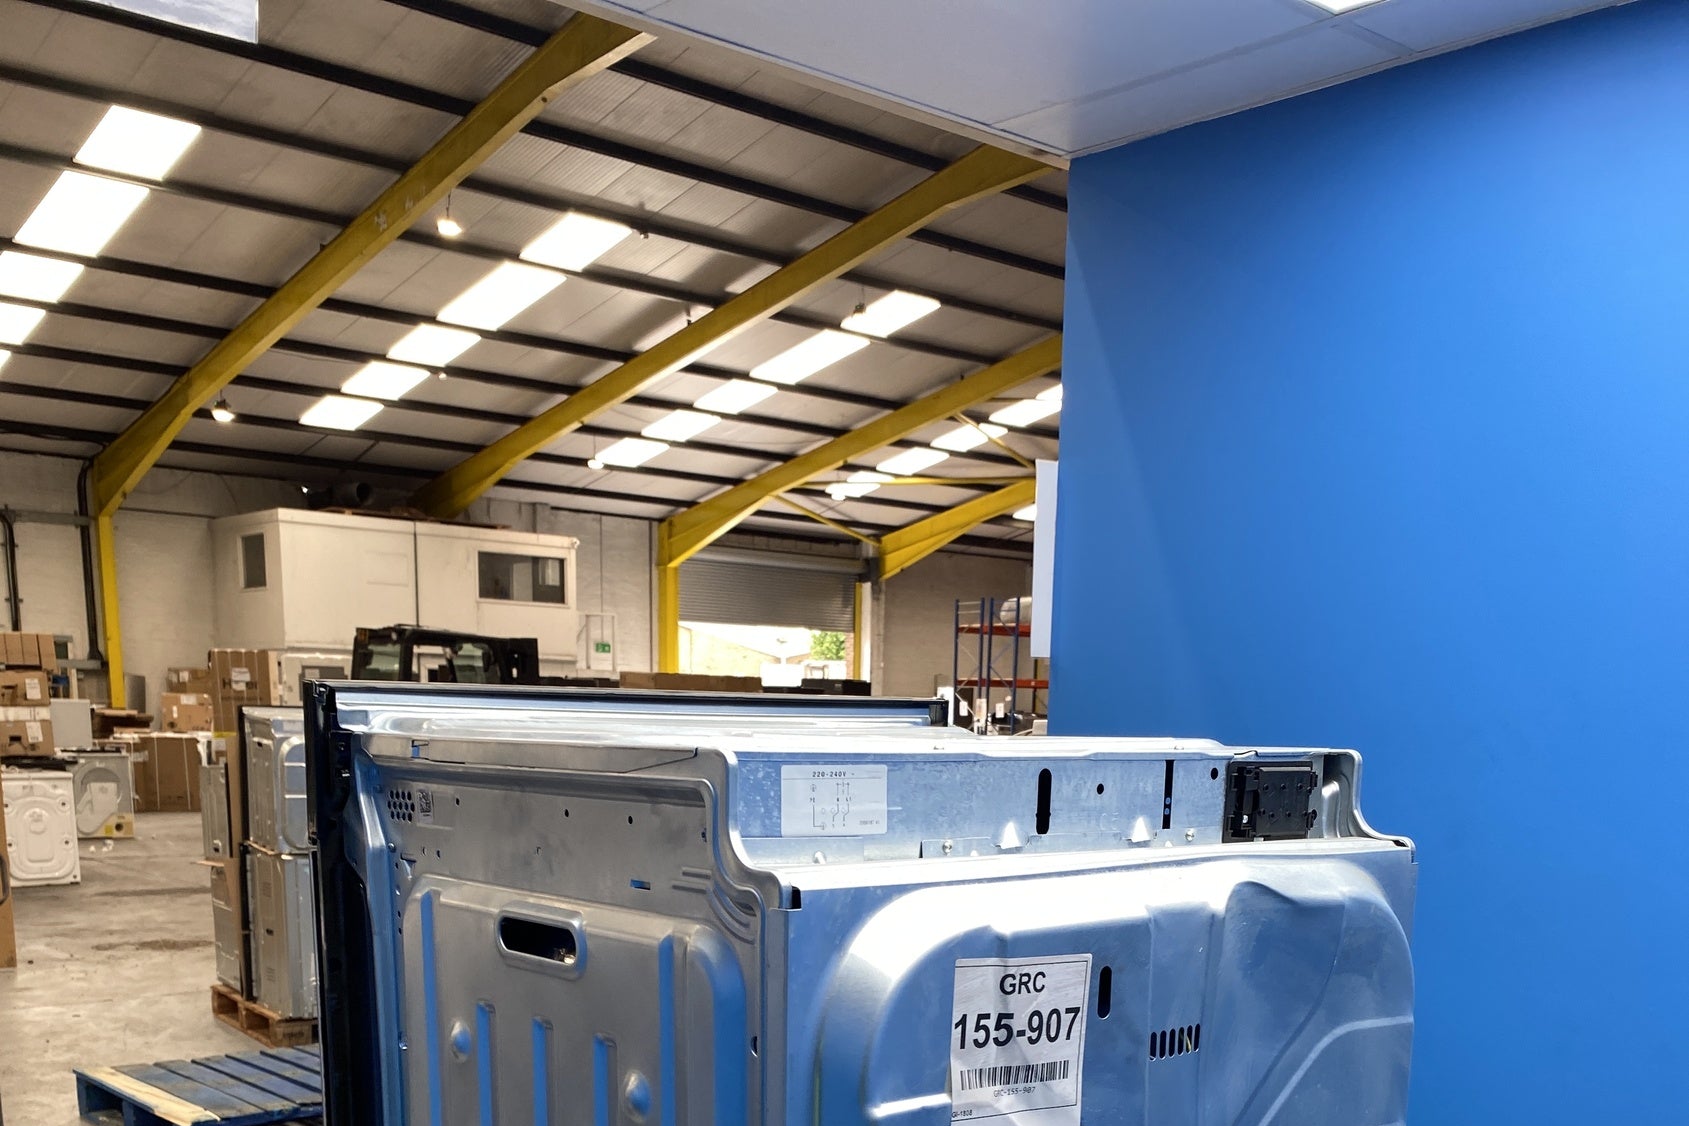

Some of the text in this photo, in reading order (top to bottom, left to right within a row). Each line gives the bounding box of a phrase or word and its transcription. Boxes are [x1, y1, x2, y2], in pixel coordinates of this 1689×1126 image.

[999, 971, 1046, 996] GRC
[954, 1006, 1081, 1050] 155-907
[993, 1086, 1036, 1098] GRC-155-907
